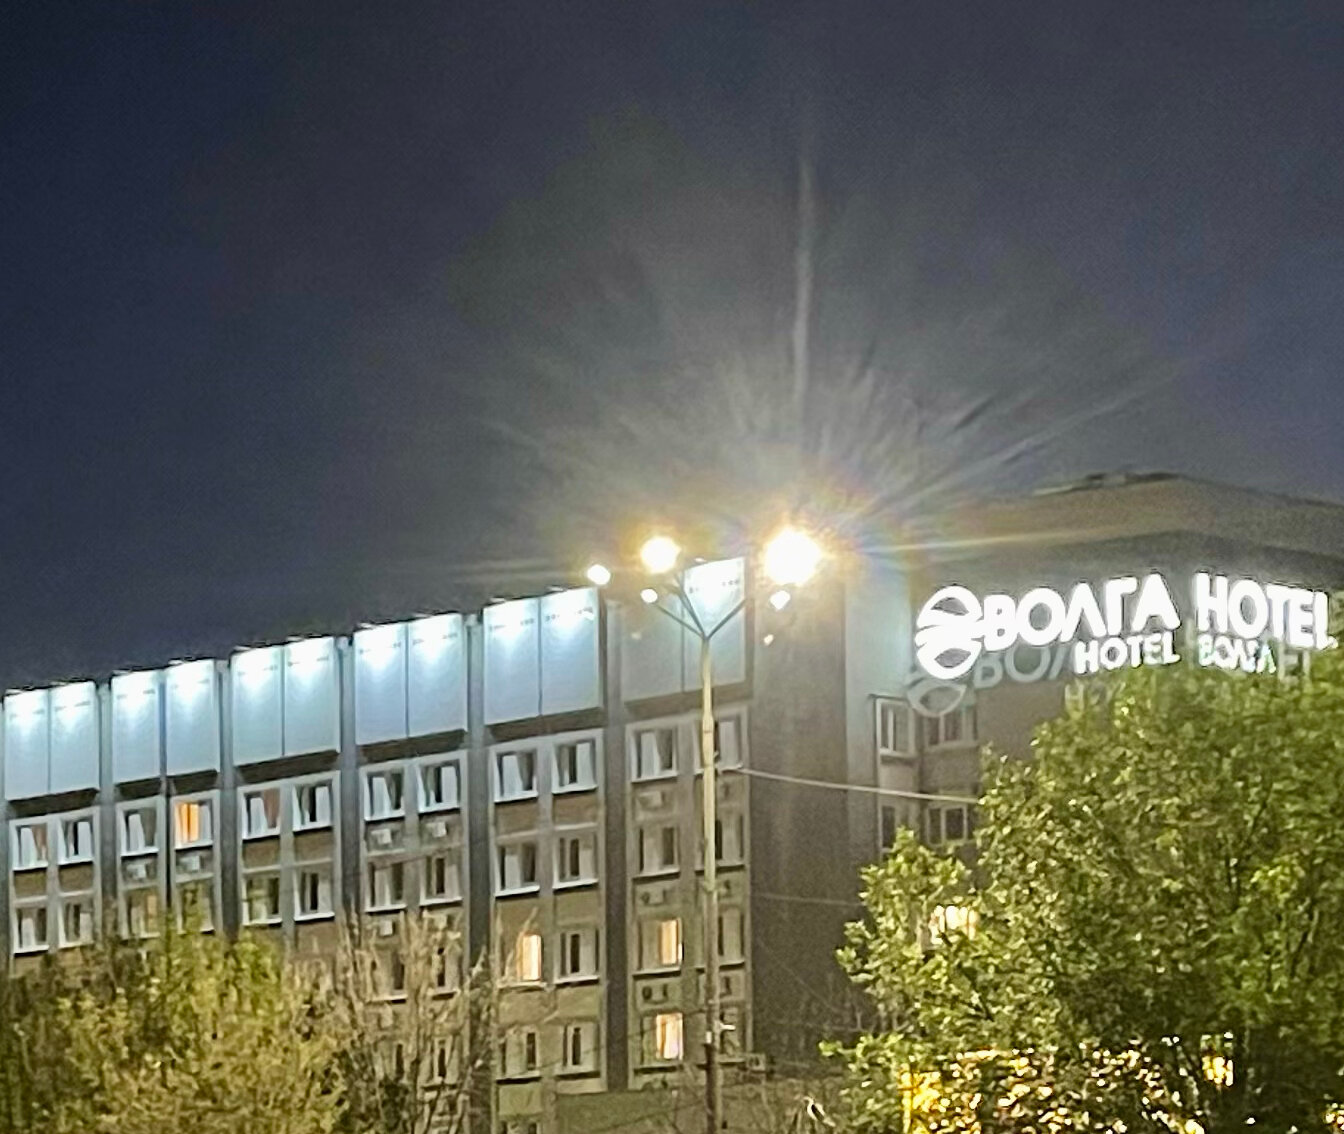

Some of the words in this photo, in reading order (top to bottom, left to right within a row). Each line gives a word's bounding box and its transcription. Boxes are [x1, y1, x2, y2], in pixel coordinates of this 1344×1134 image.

[983, 572, 1181, 652] ВОЛГА
[1193, 571, 1338, 650] HOTEL
[1073, 630, 1181, 674] HOTEL
